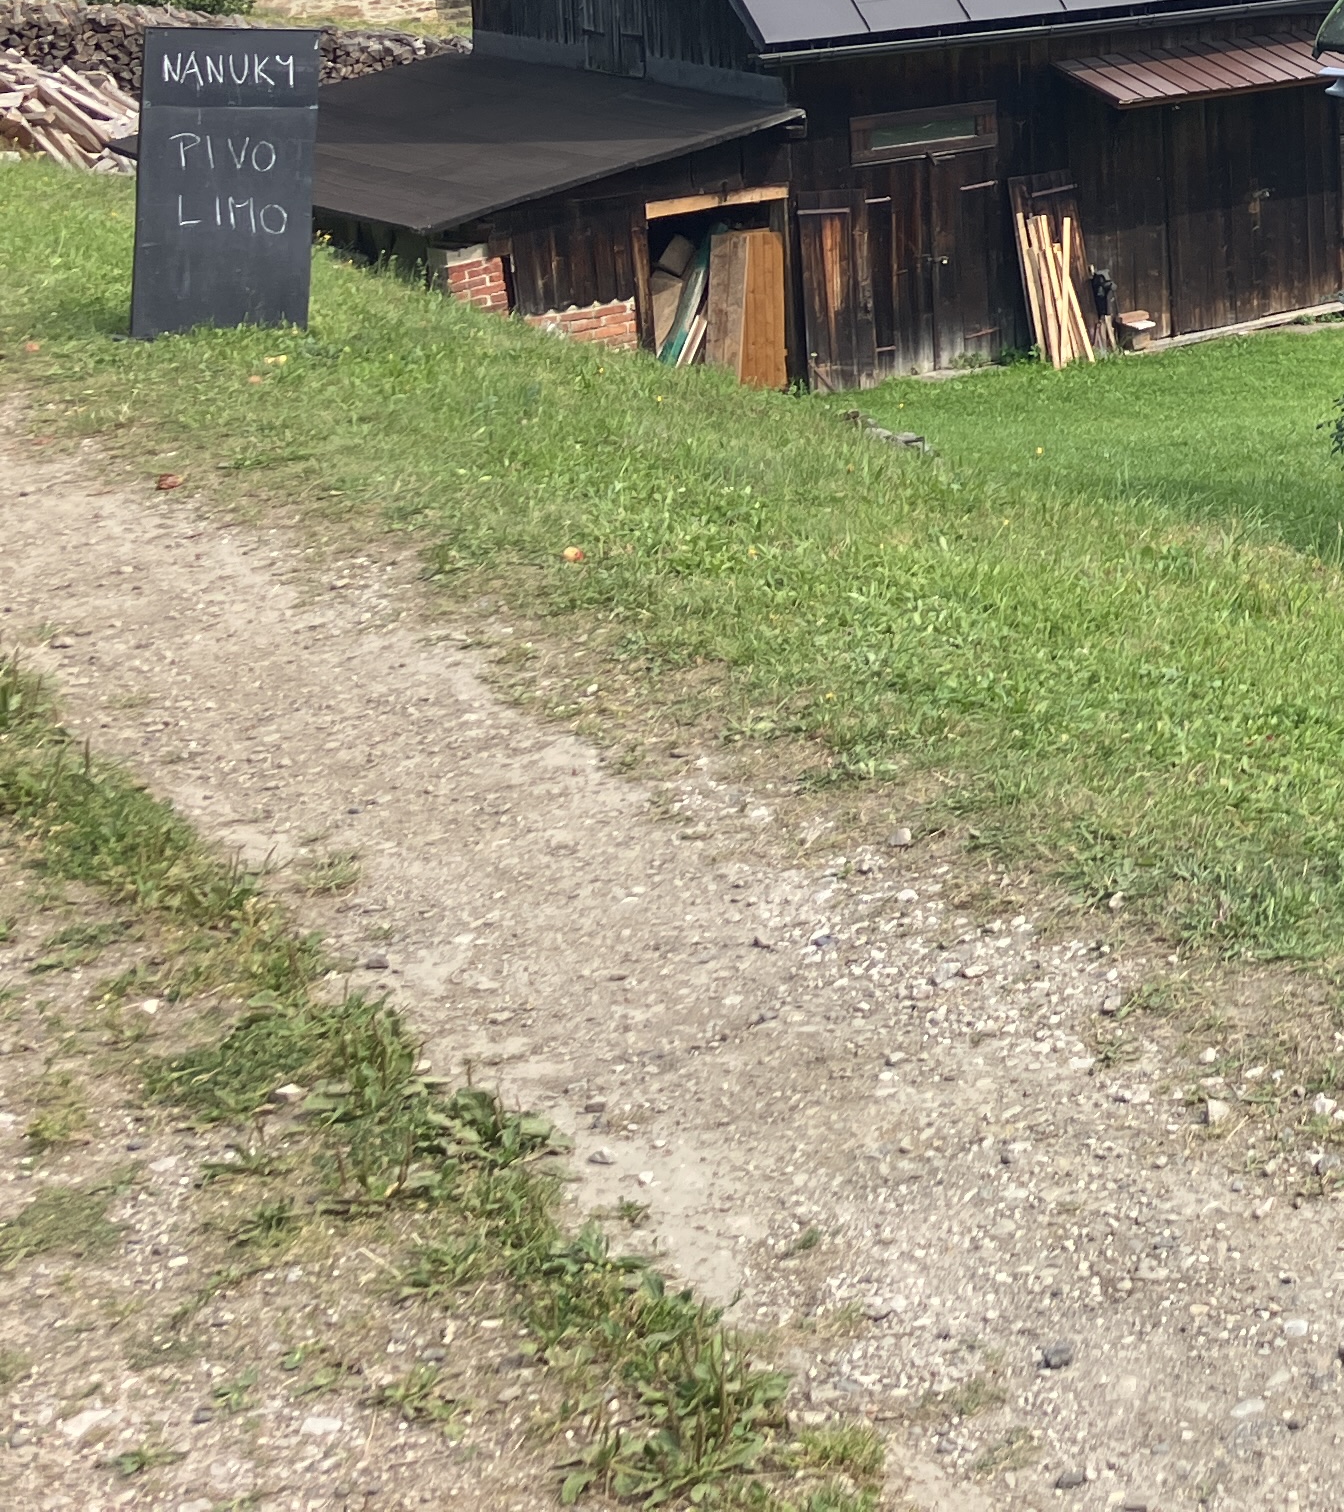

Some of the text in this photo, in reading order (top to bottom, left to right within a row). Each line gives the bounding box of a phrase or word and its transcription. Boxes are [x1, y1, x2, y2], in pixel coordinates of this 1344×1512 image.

[163, 51, 295, 88] NANUKY
[169, 132, 276, 172] PIVO
[178, 194, 288, 235] LIMO
